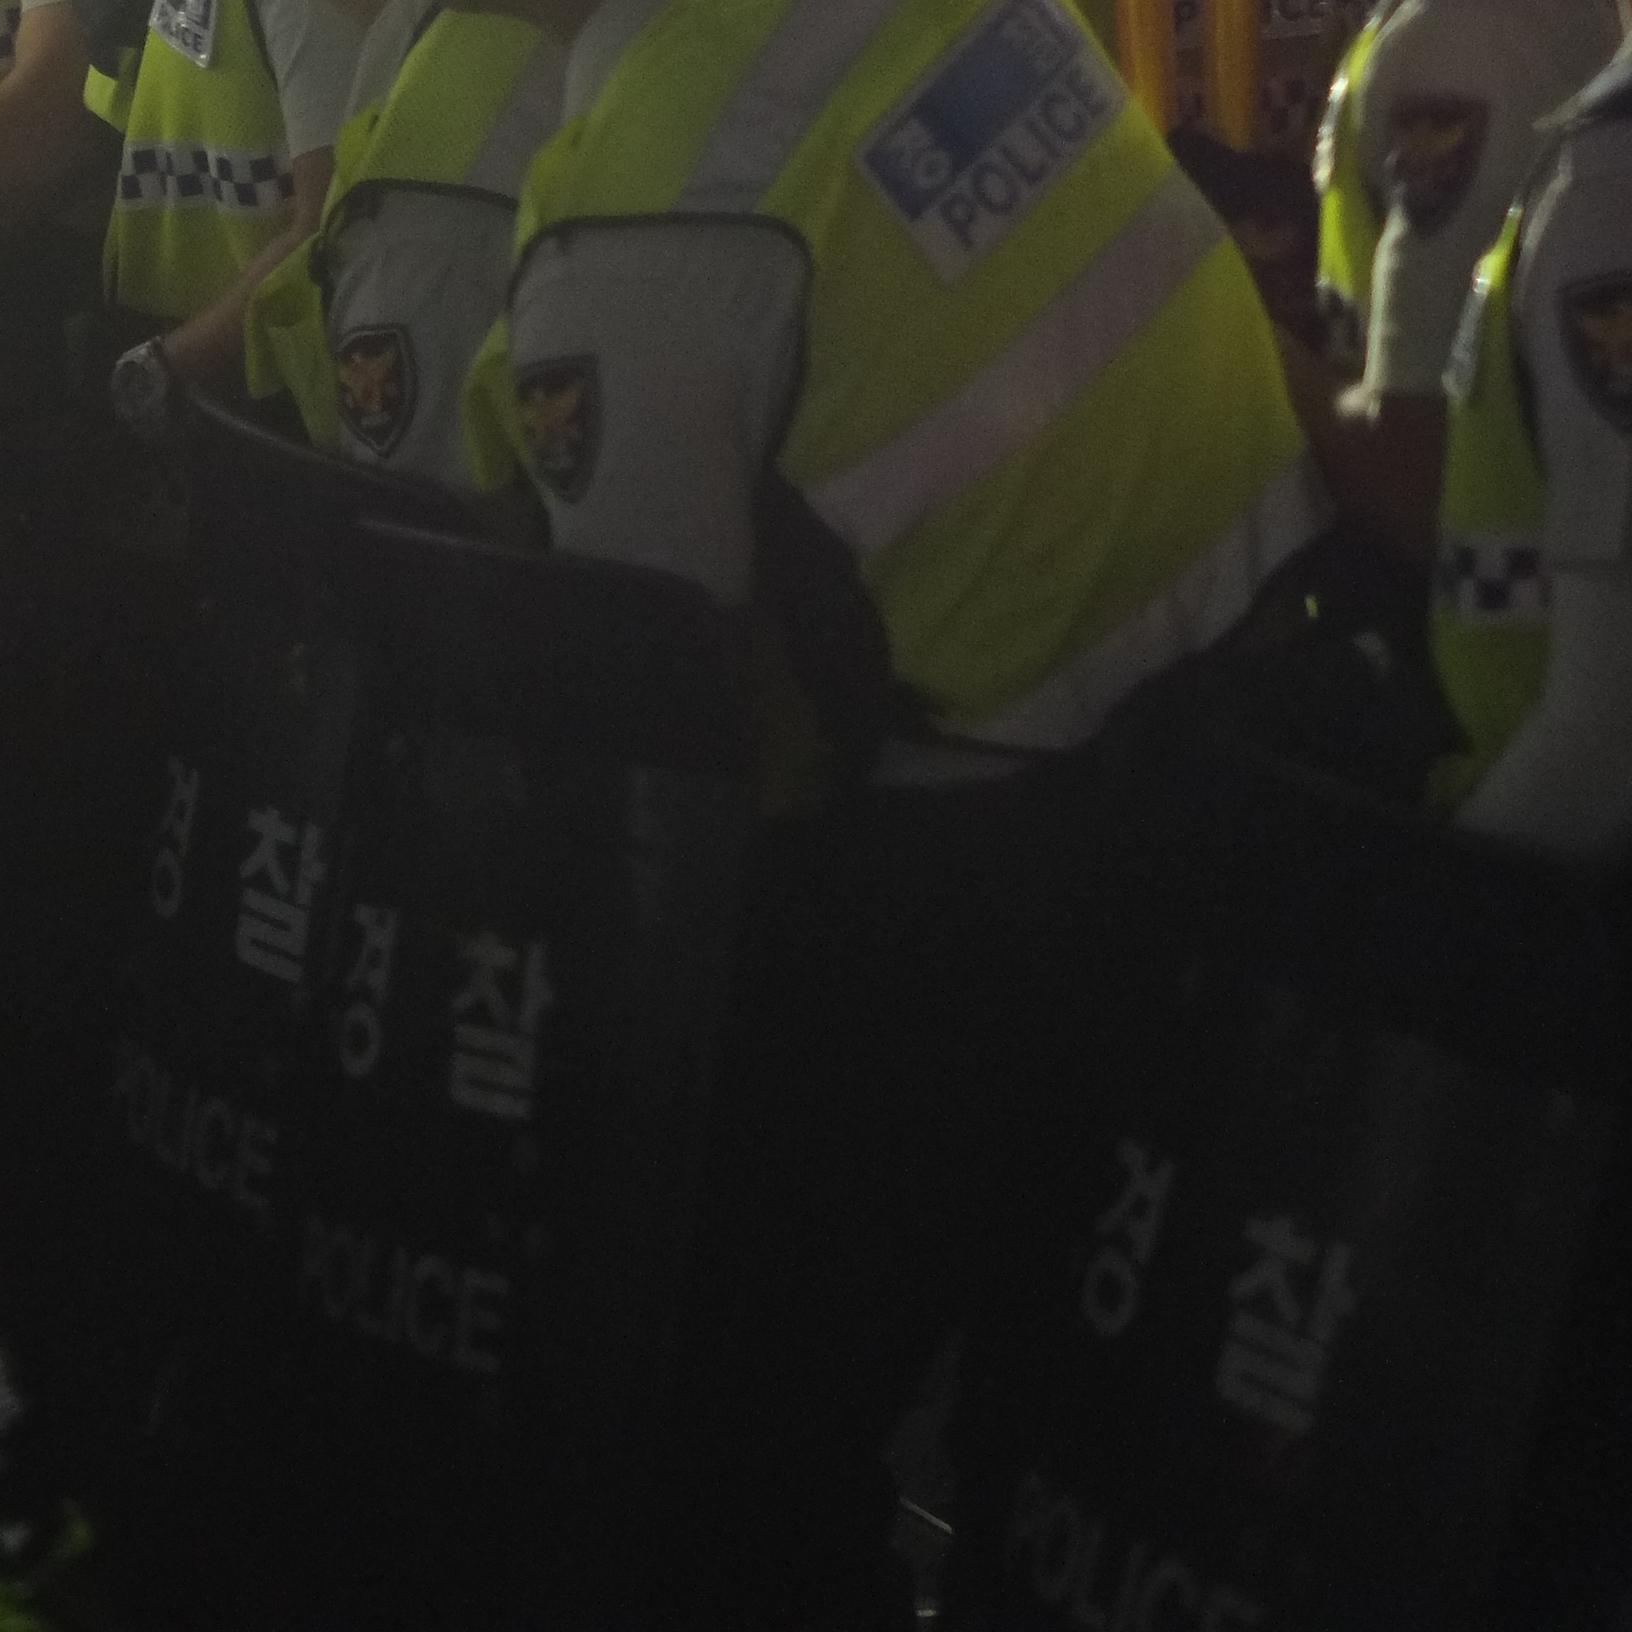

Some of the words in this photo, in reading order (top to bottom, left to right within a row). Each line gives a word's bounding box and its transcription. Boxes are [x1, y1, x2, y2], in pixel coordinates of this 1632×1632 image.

[939, 67, 1108, 250] POLICE
[338, 904, 556, 1121] 경찰
[113, 1040, 279, 1212] POLICE
[296, 1216, 511, 1376] POLICE
[1082, 1138, 1358, 1438] 경찰
